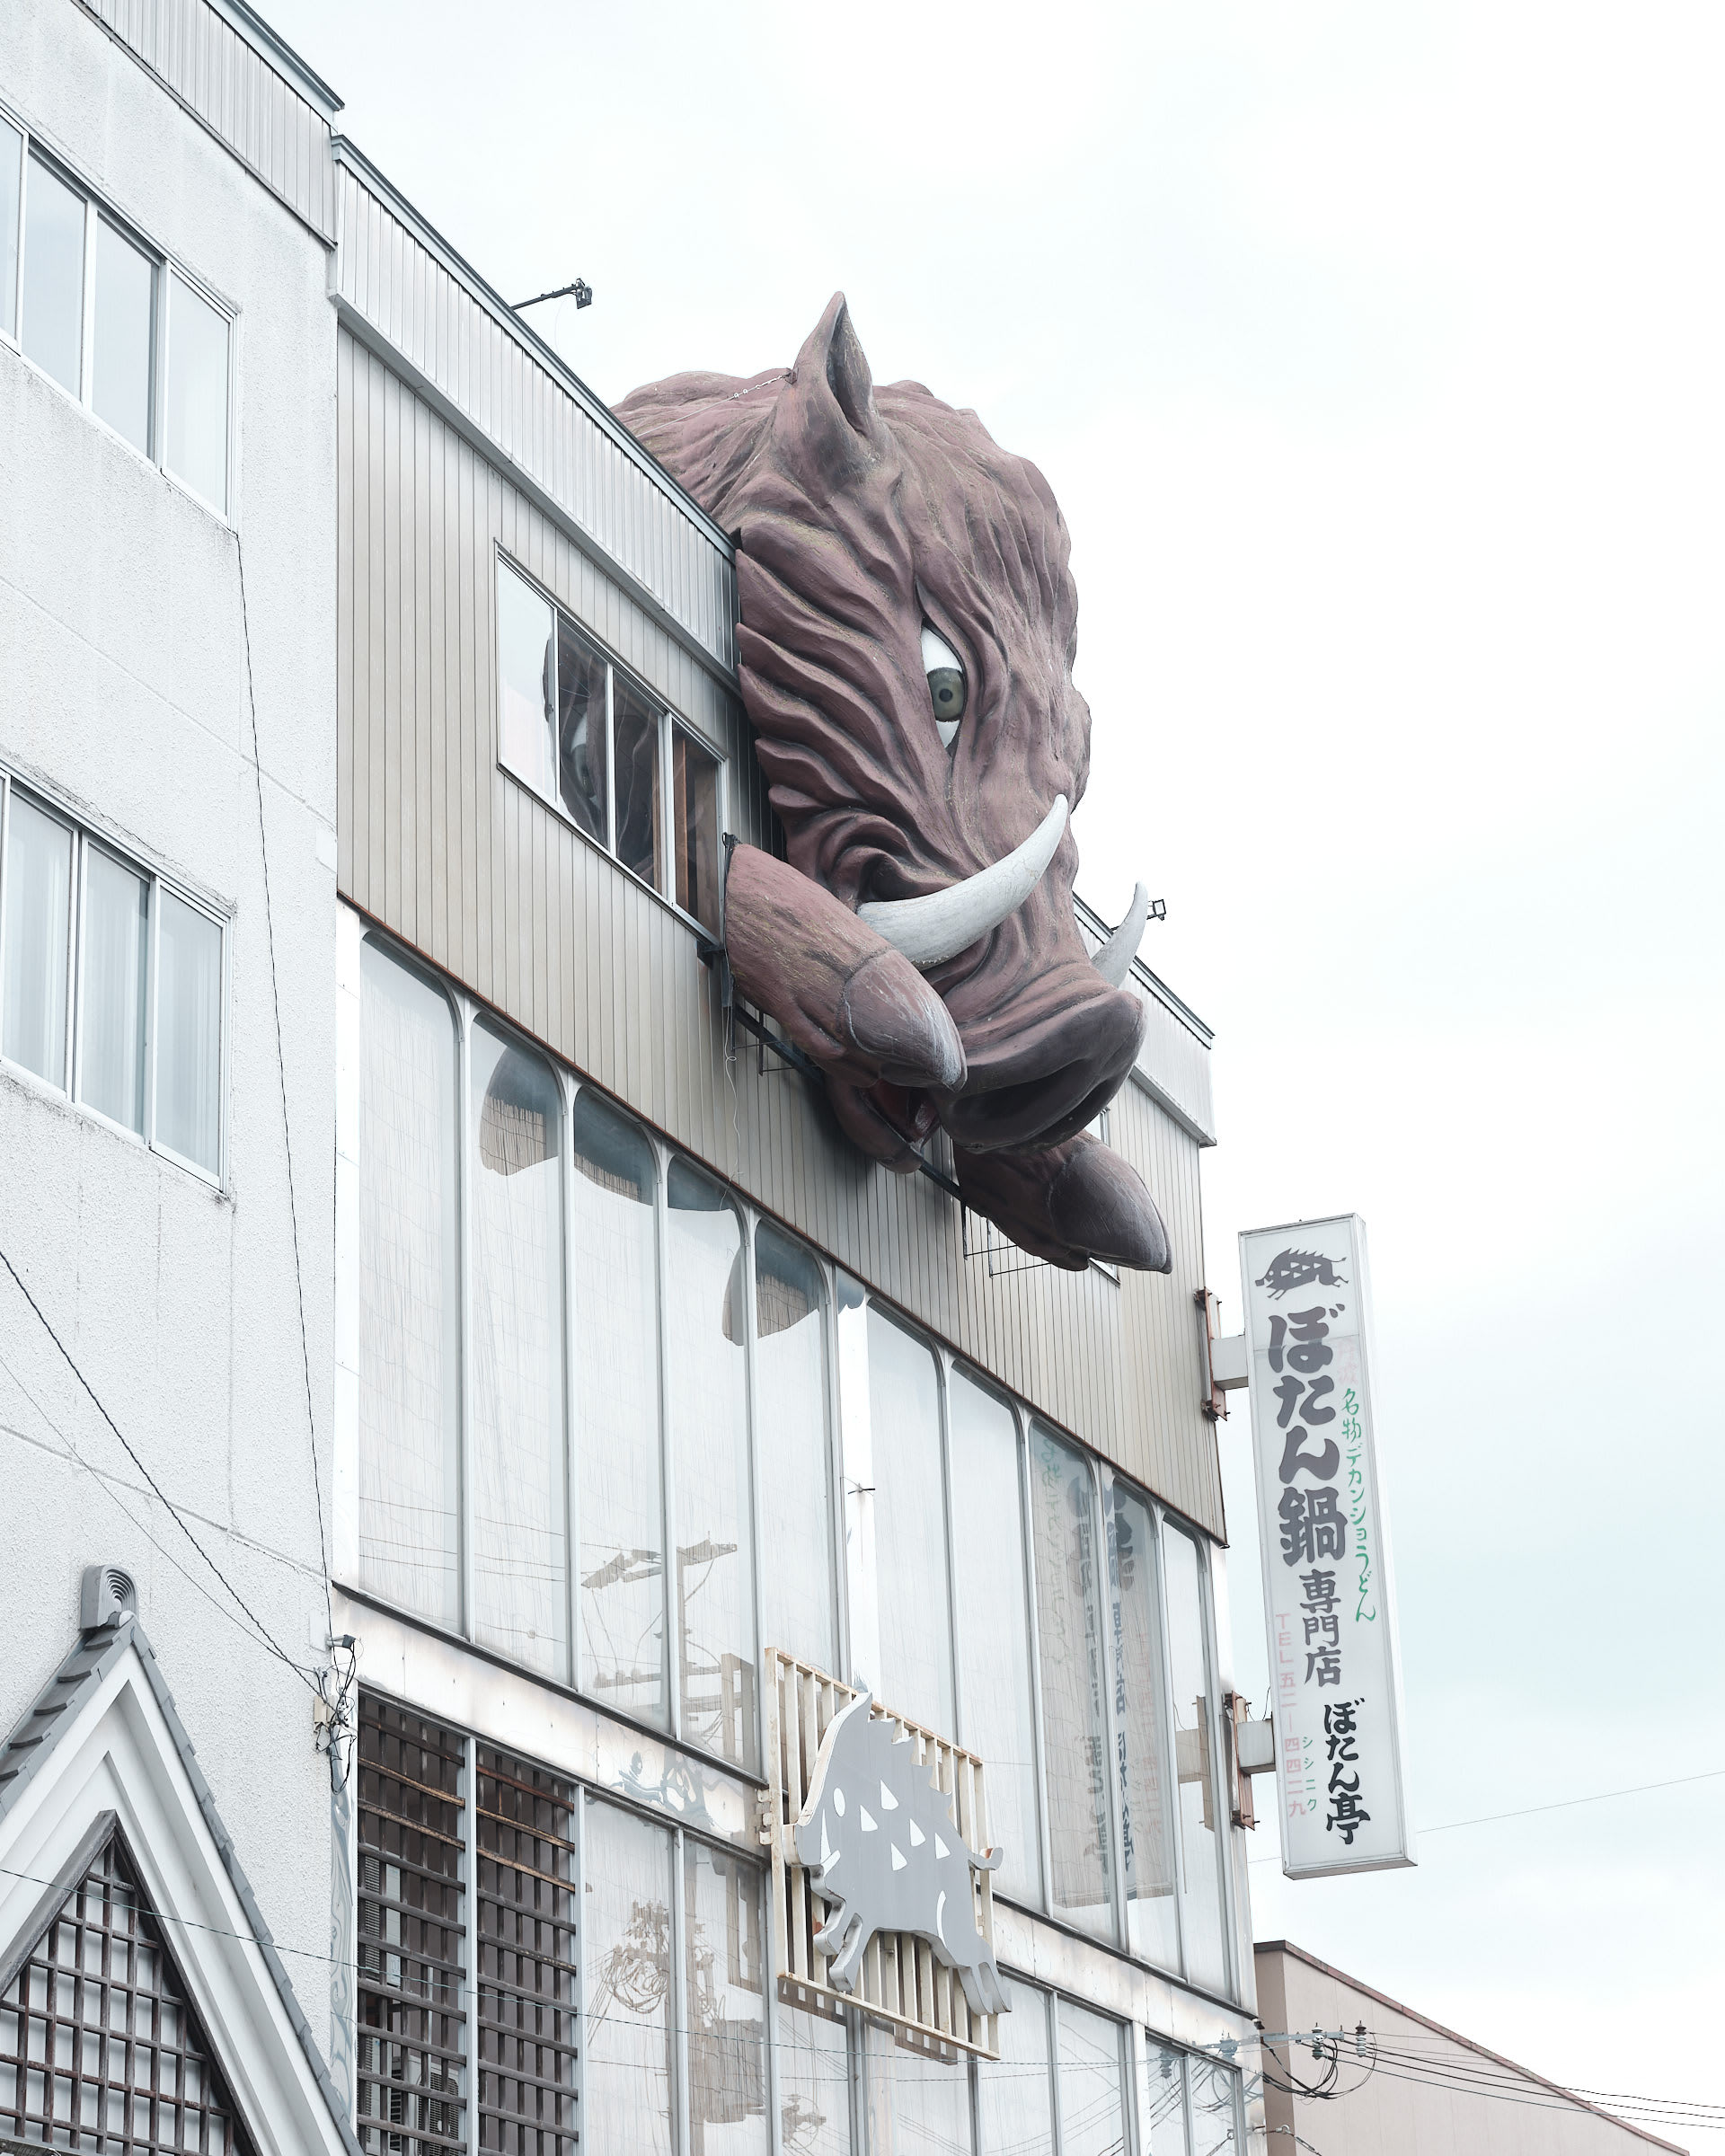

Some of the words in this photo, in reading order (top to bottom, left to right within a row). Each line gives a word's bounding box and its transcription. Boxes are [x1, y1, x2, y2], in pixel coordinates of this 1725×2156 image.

[1341, 1387, 1376, 1622] 名物デカンショうどん
[1276, 1613, 1294, 1665] TEL
[1324, 1697, 1371, 1845] ぼたん亭
